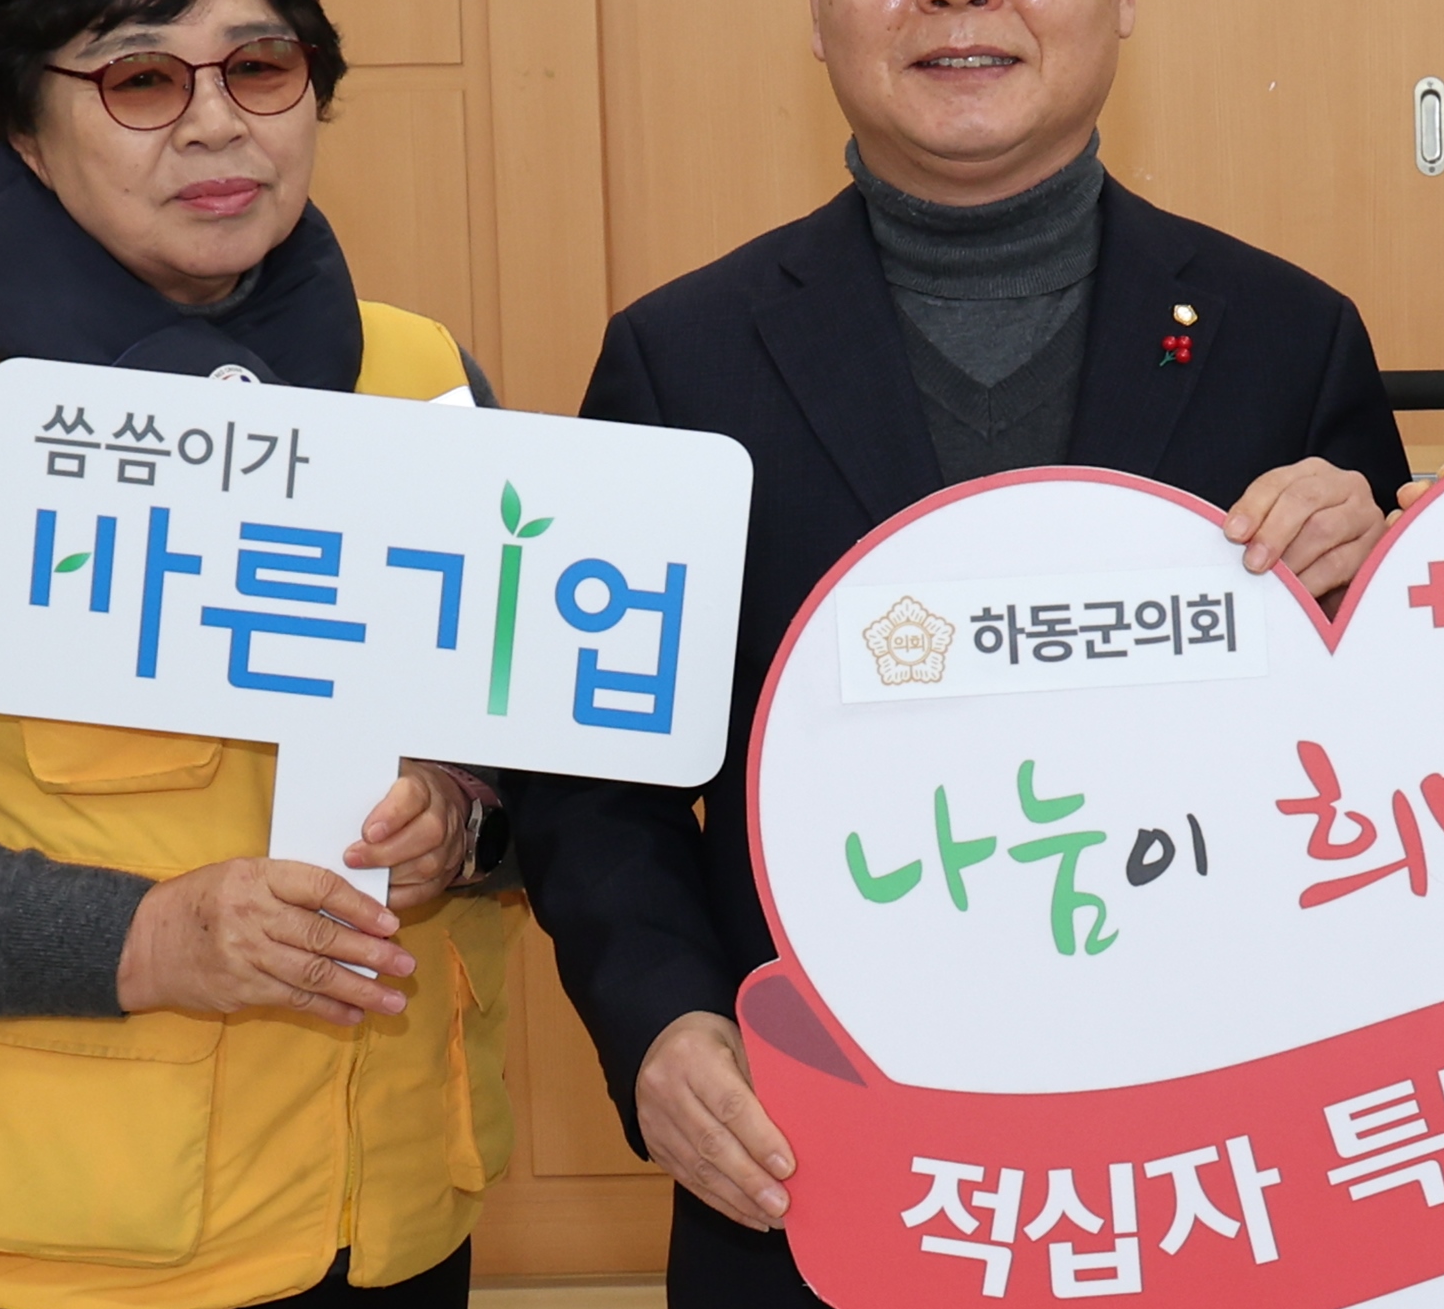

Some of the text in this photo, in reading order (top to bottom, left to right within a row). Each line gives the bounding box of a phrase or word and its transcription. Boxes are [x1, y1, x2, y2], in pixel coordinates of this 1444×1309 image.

[33, 403, 311, 500] 씀씀이가
[28, 480, 689, 736] 바른기업
[893, 633, 926, 653] 의회
[969, 591, 1239, 666] 하동군의회
[900, 1134, 1282, 1300] 적십자
